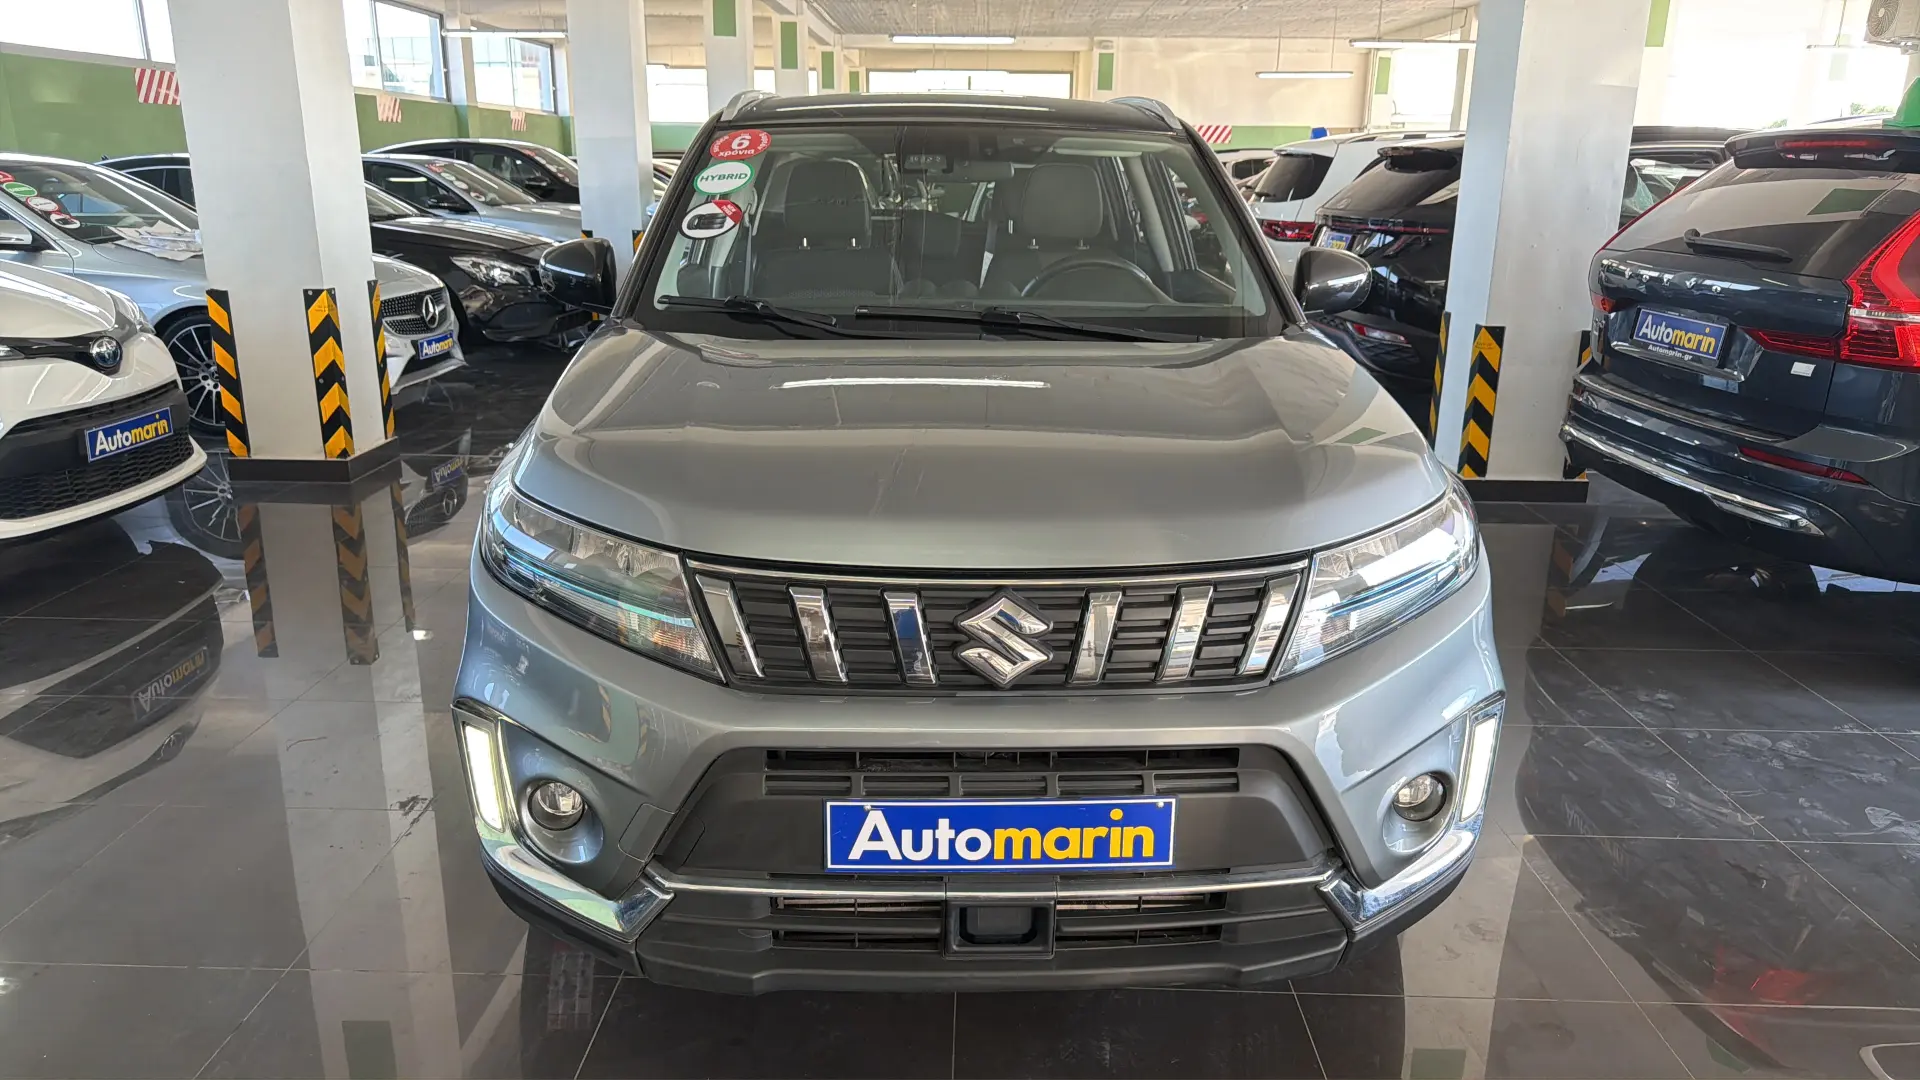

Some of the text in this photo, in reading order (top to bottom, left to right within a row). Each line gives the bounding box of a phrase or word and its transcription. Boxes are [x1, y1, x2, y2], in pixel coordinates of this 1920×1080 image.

[731, 135, 751, 150] 6
[718, 149, 755, 157] χρόνια
[700, 172, 748, 182] HYBRID
[1639, 314, 1716, 354] Automarin
[422, 335, 453, 357] Automarin
[1648, 343, 1693, 361] Automarin.gr
[95, 413, 168, 455] Automarin
[848, 808, 1154, 861] Automarin
